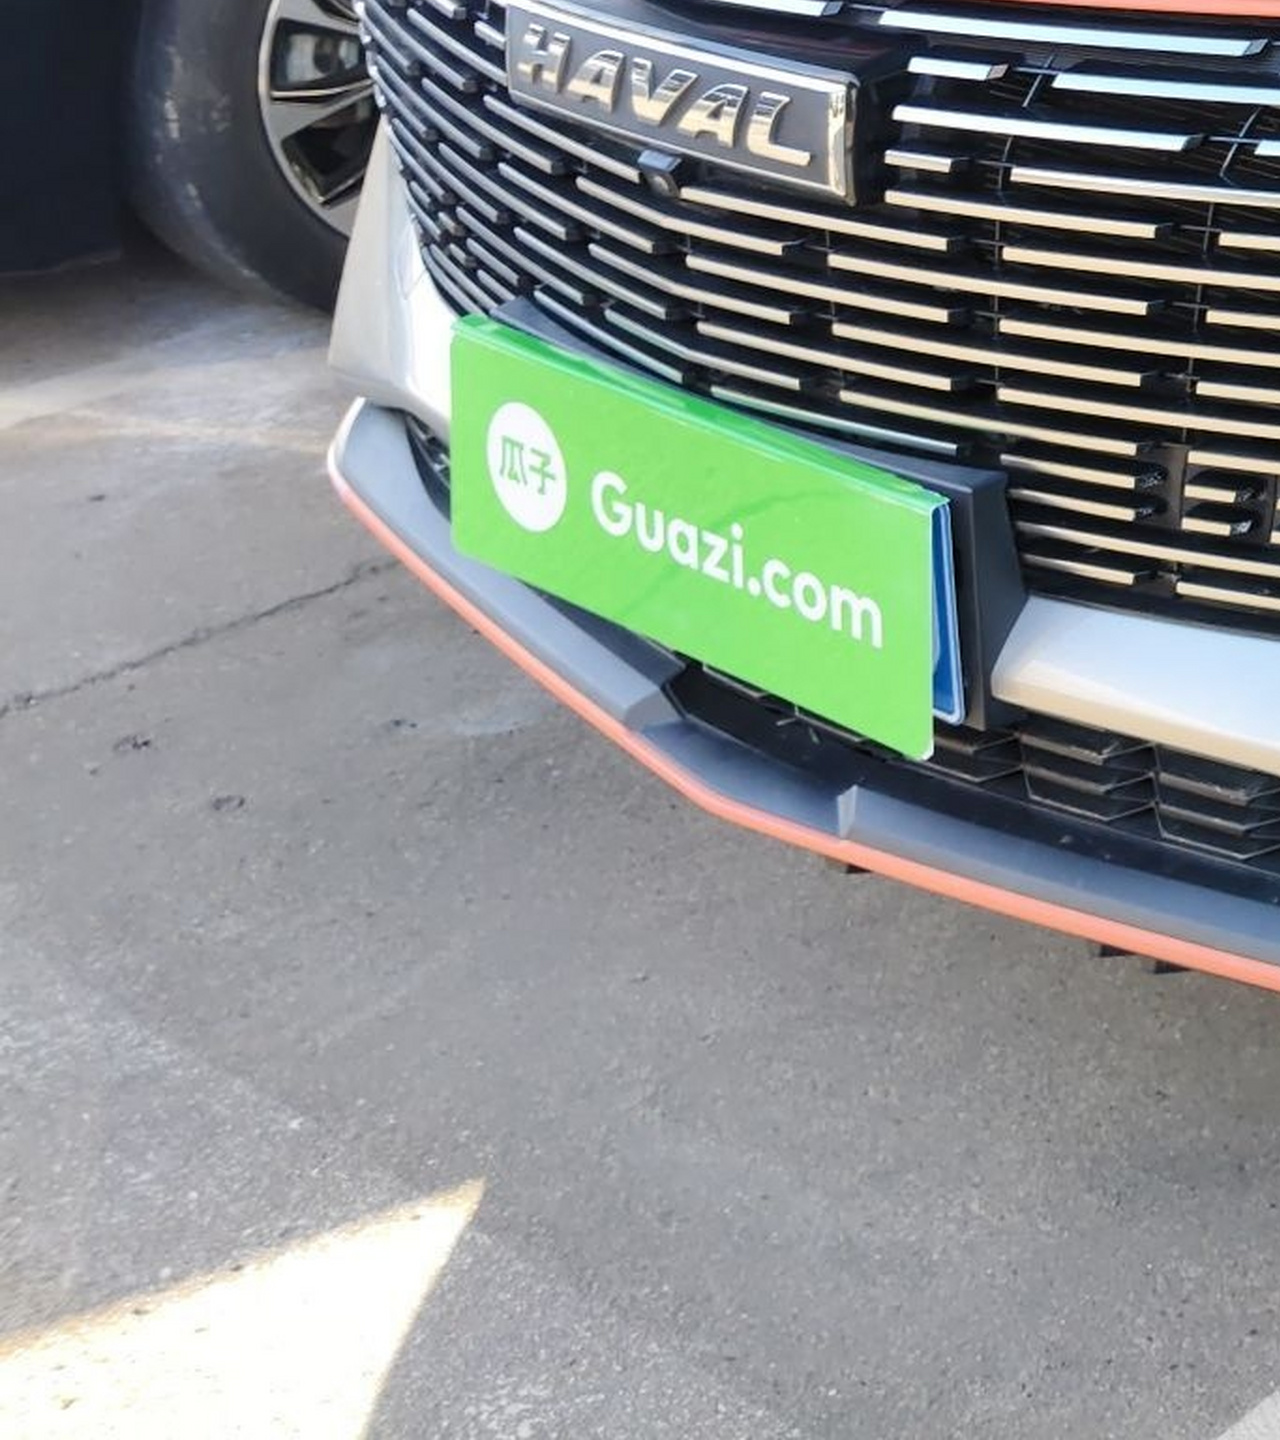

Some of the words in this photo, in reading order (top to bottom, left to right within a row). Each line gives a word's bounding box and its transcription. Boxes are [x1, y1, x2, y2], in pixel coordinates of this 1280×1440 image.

[516, 22, 812, 167] HAVAL
[498, 431, 557, 499] 瓜子
[590, 471, 884, 649] Guazi.com
